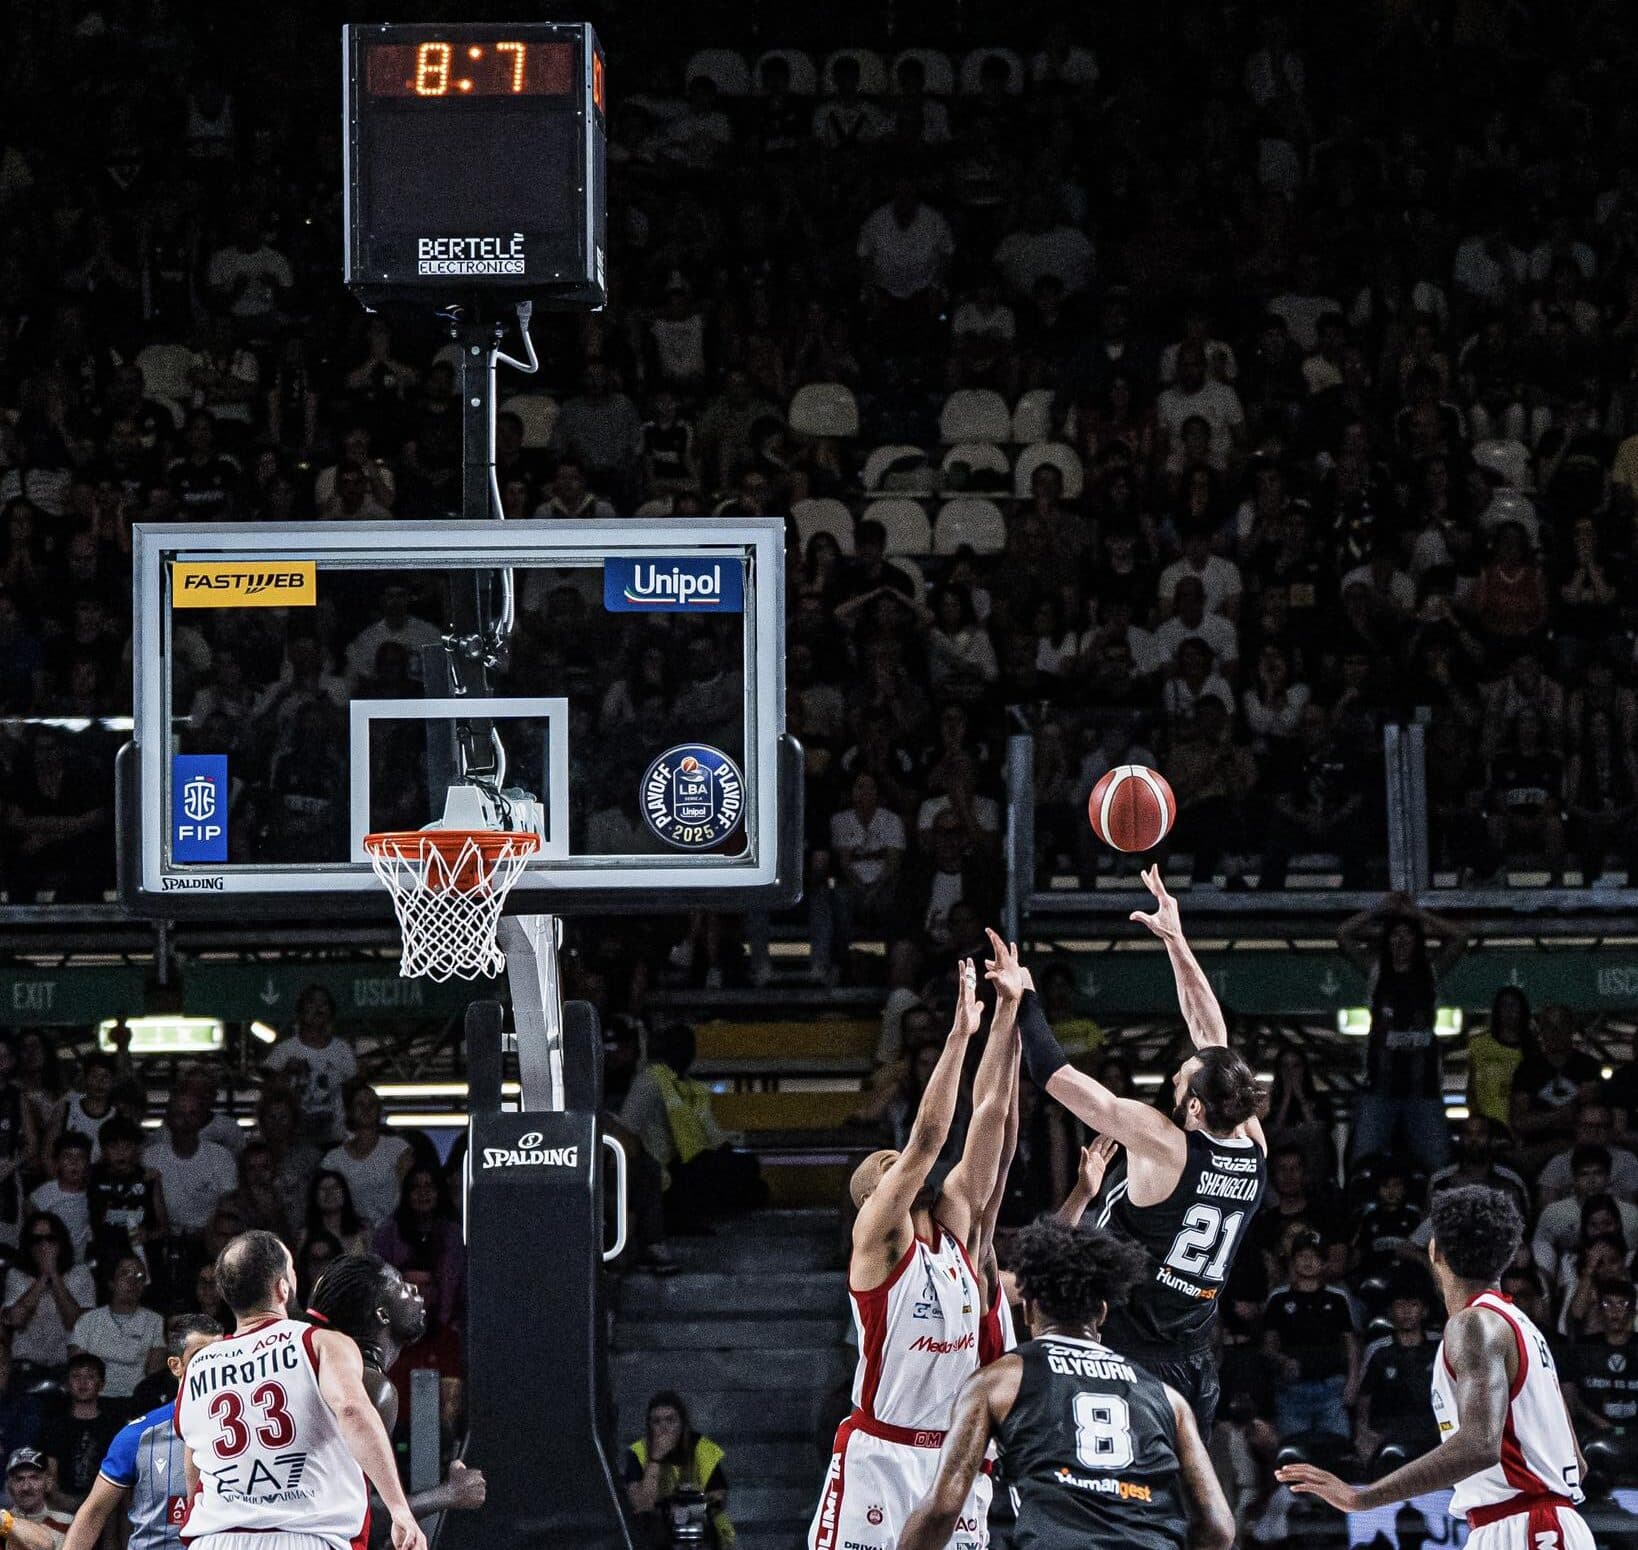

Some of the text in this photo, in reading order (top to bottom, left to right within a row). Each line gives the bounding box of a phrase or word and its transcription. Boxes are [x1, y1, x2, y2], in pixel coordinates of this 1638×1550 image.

[418, 233, 525, 259] BERTELÈ
[418, 260, 525, 275] ELECTRONICS
[184, 573, 305, 594] FASTWEB
[634, 564, 721, 604] Unipol
[647, 763, 672, 829] PLAYOFF
[680, 784, 708, 795] LBA
[714, 764, 740, 829] PLAYOFF
[682, 806, 706, 817] Unipol
[178, 825, 221, 841] FIP
[672, 825, 715, 842] 2025
[162, 877, 224, 891] SPALDING
[483, 1146, 578, 1169] SPALDING
[1196, 1170, 1259, 1202] SHENGELIA
[1163, 1202, 1245, 1281] 21
[252, 1331, 292, 1354] AON
[189, 1340, 298, 1402] MIROTIĆ
[1047, 1355, 1138, 1384] CLYBURN
[208, 1380, 296, 1460] 33
[1072, 1392, 1134, 1470] 8
